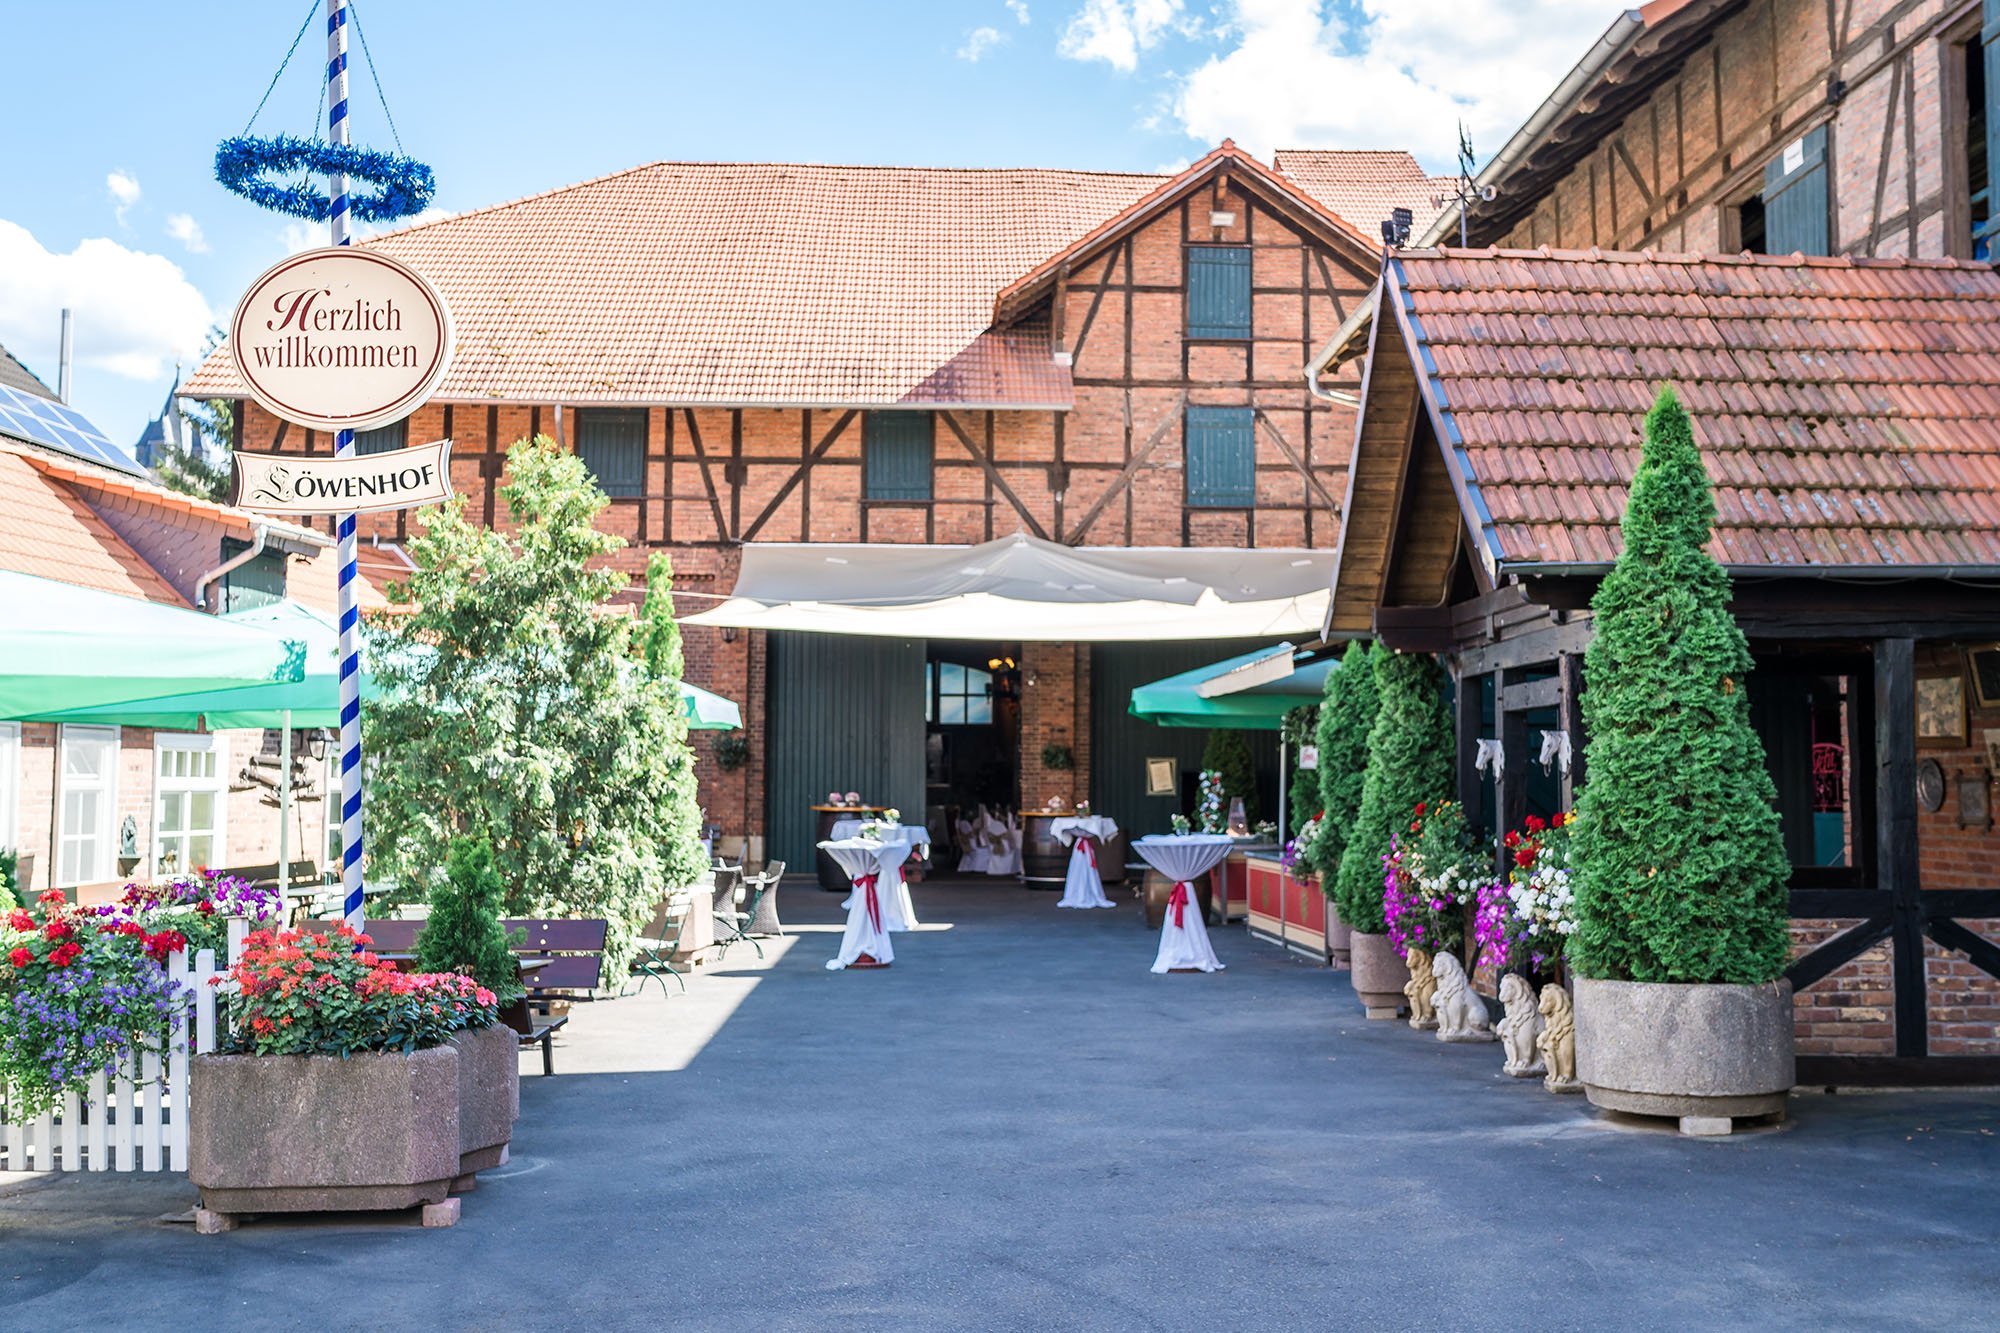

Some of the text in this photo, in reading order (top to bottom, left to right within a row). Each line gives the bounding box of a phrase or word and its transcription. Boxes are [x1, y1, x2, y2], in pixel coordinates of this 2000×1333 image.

[266, 288, 402, 332] Herzlich
[253, 336, 419, 369] willkommen
[250, 462, 434, 503] LÖWENHOF
